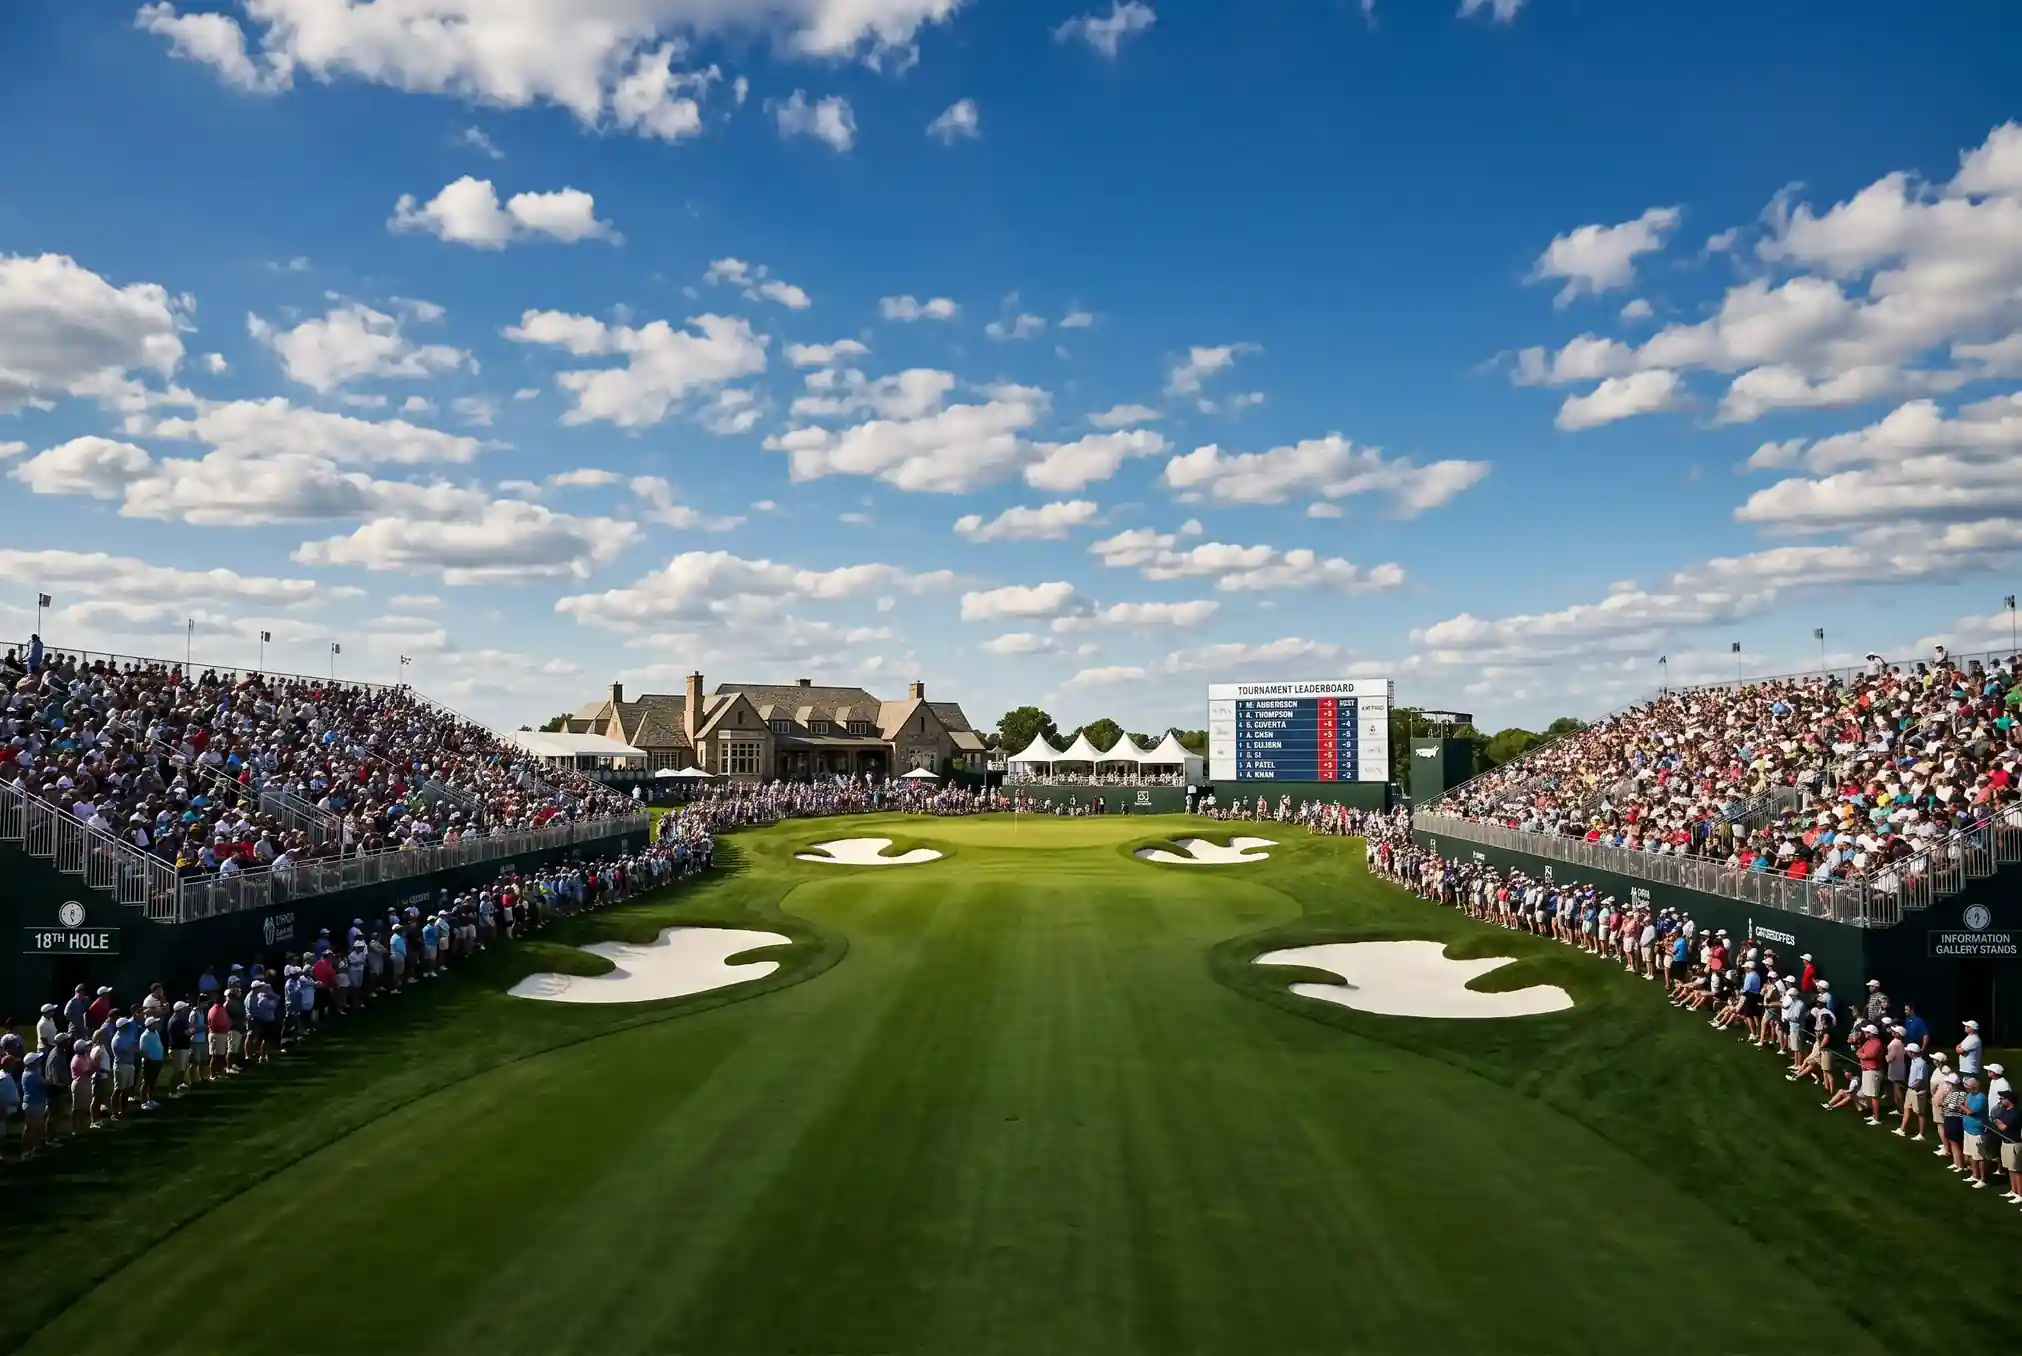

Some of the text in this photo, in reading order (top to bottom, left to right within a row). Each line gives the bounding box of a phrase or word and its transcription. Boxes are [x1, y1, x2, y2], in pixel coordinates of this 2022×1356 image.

[1238, 683, 1355, 695] TOURNAMENT LEADERBOARD
[34, 932, 109, 950] 18TH HOLE
[1941, 934, 2011, 944] INFORMATION
[1936, 944, 2017, 954] GALLERY STANDS
